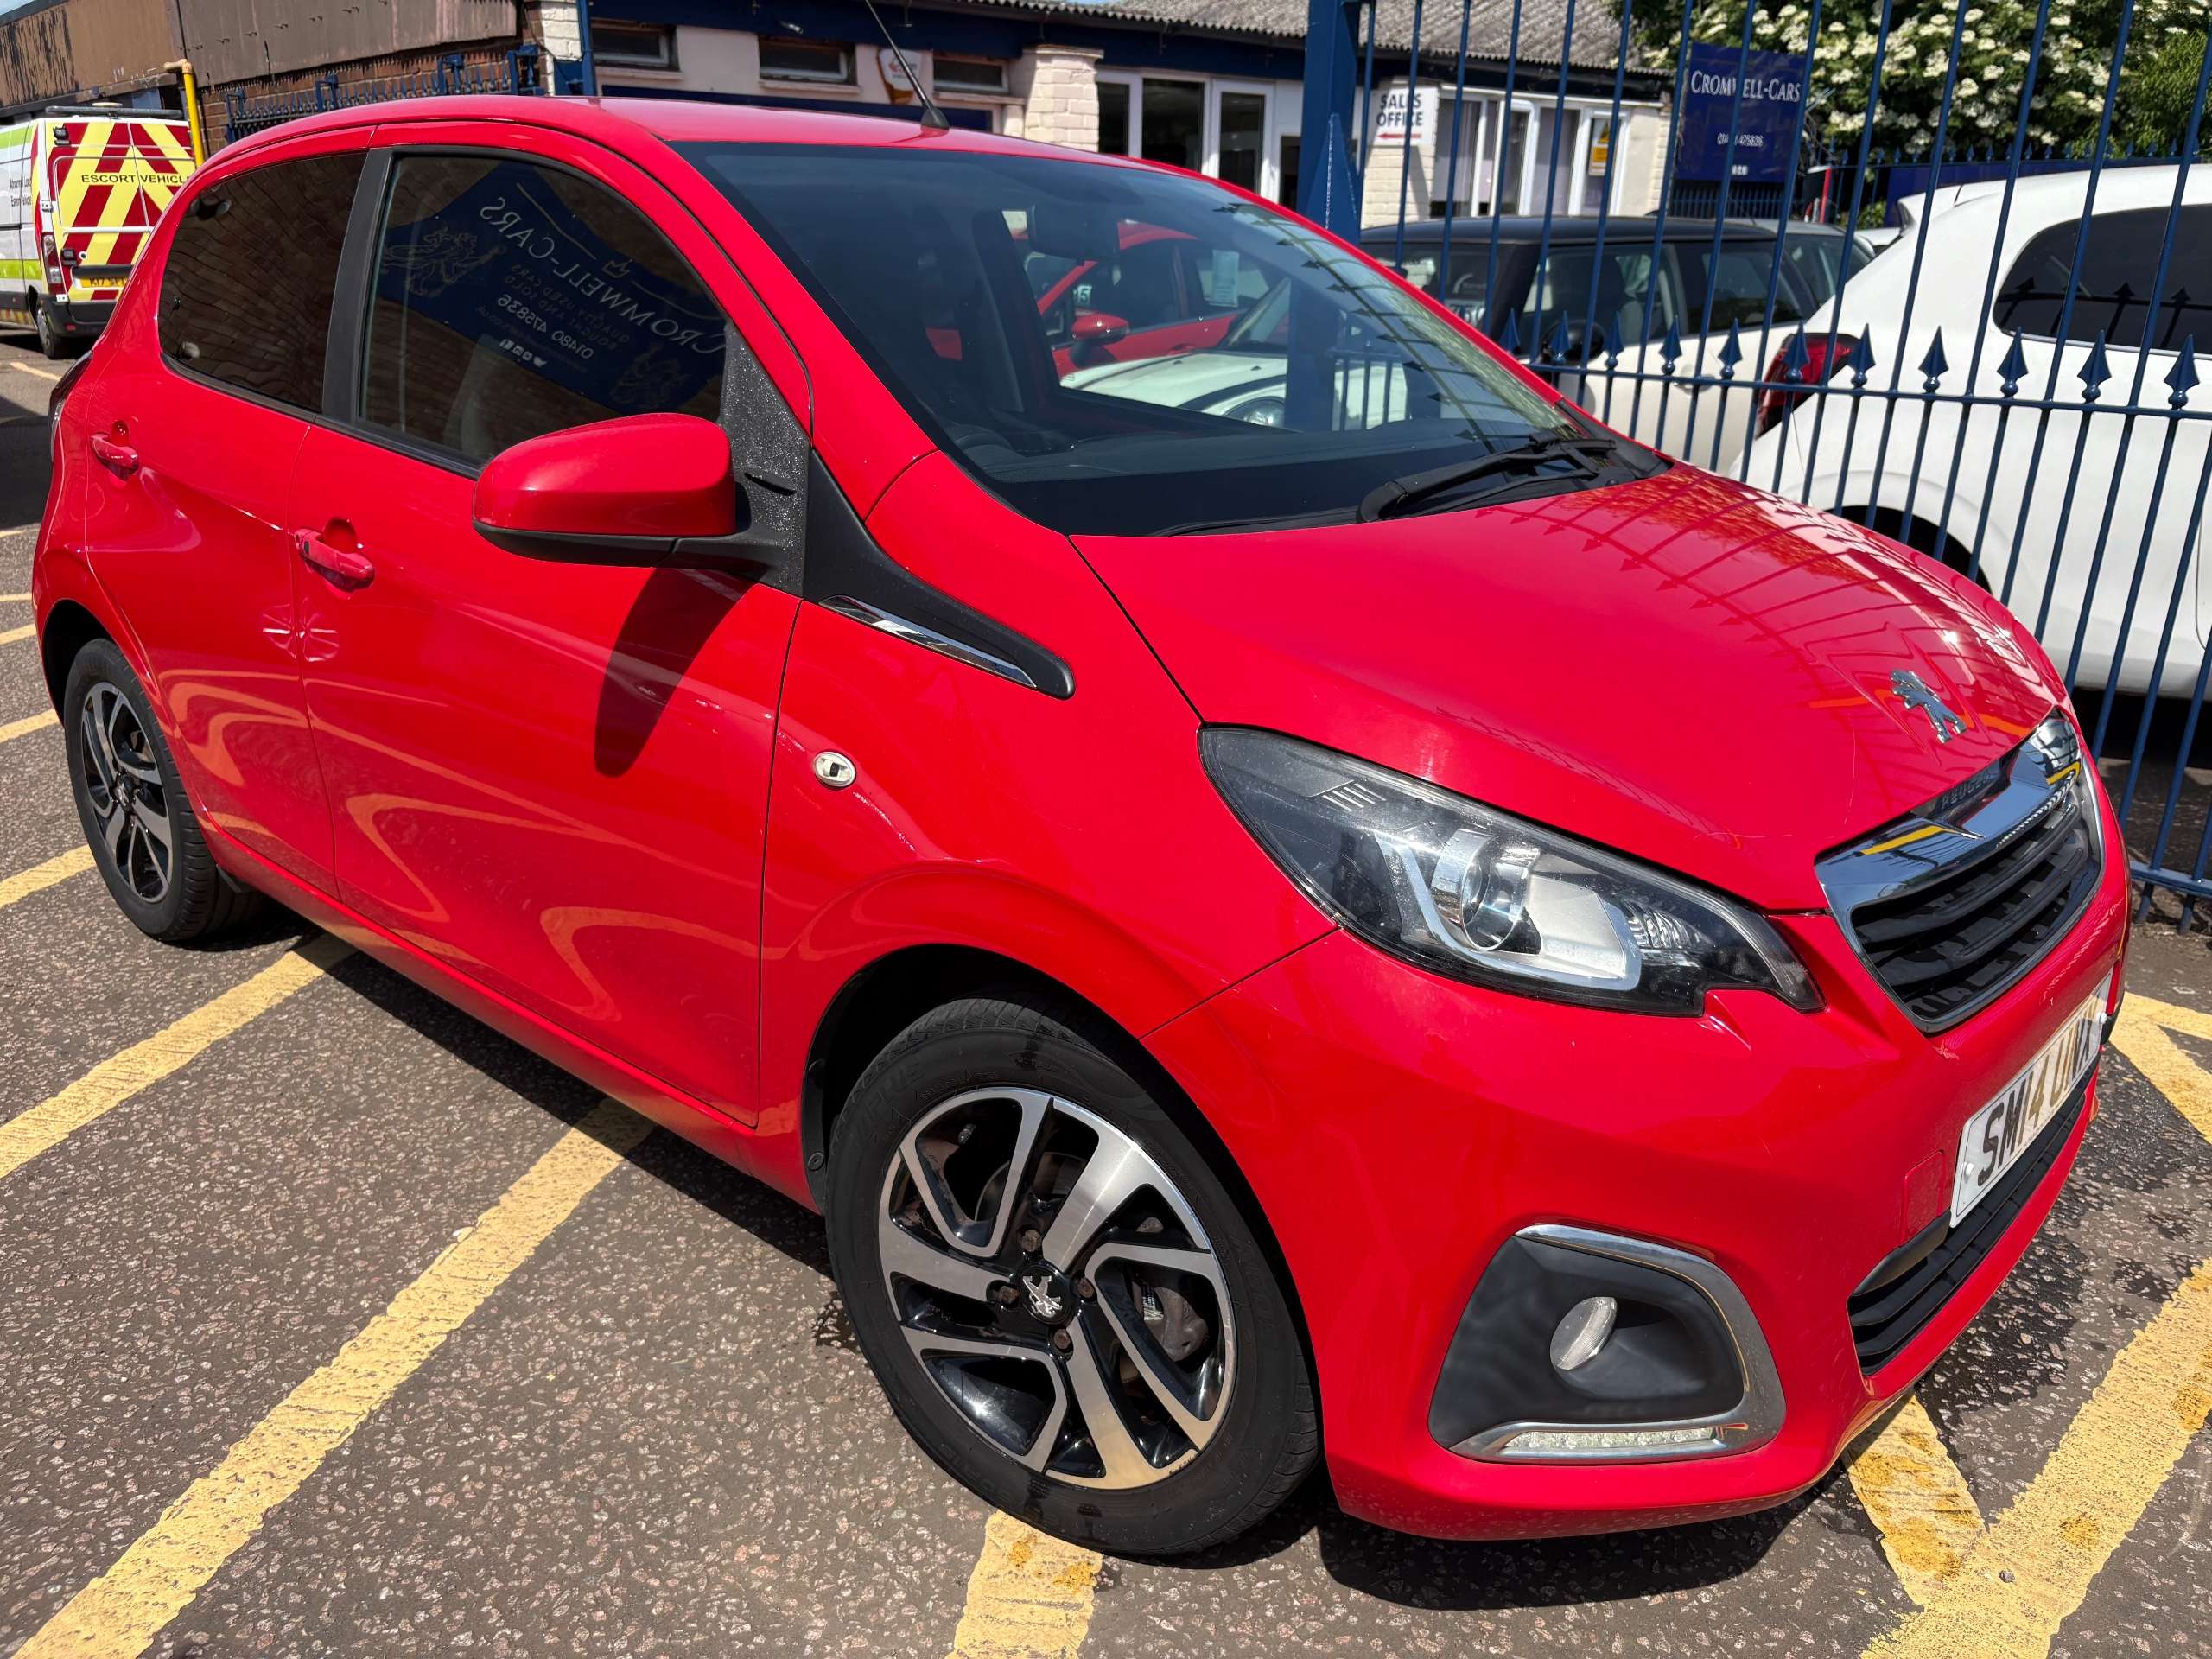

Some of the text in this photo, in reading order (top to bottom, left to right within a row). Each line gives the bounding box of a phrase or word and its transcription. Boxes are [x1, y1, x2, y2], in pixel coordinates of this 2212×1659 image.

[1691, 70, 1801, 102] CROMELL-CARS
[1380, 93, 1421, 109] SALS
[81, 174, 136, 183] ESCORT
[1978, 1054, 2049, 1186] SM14
